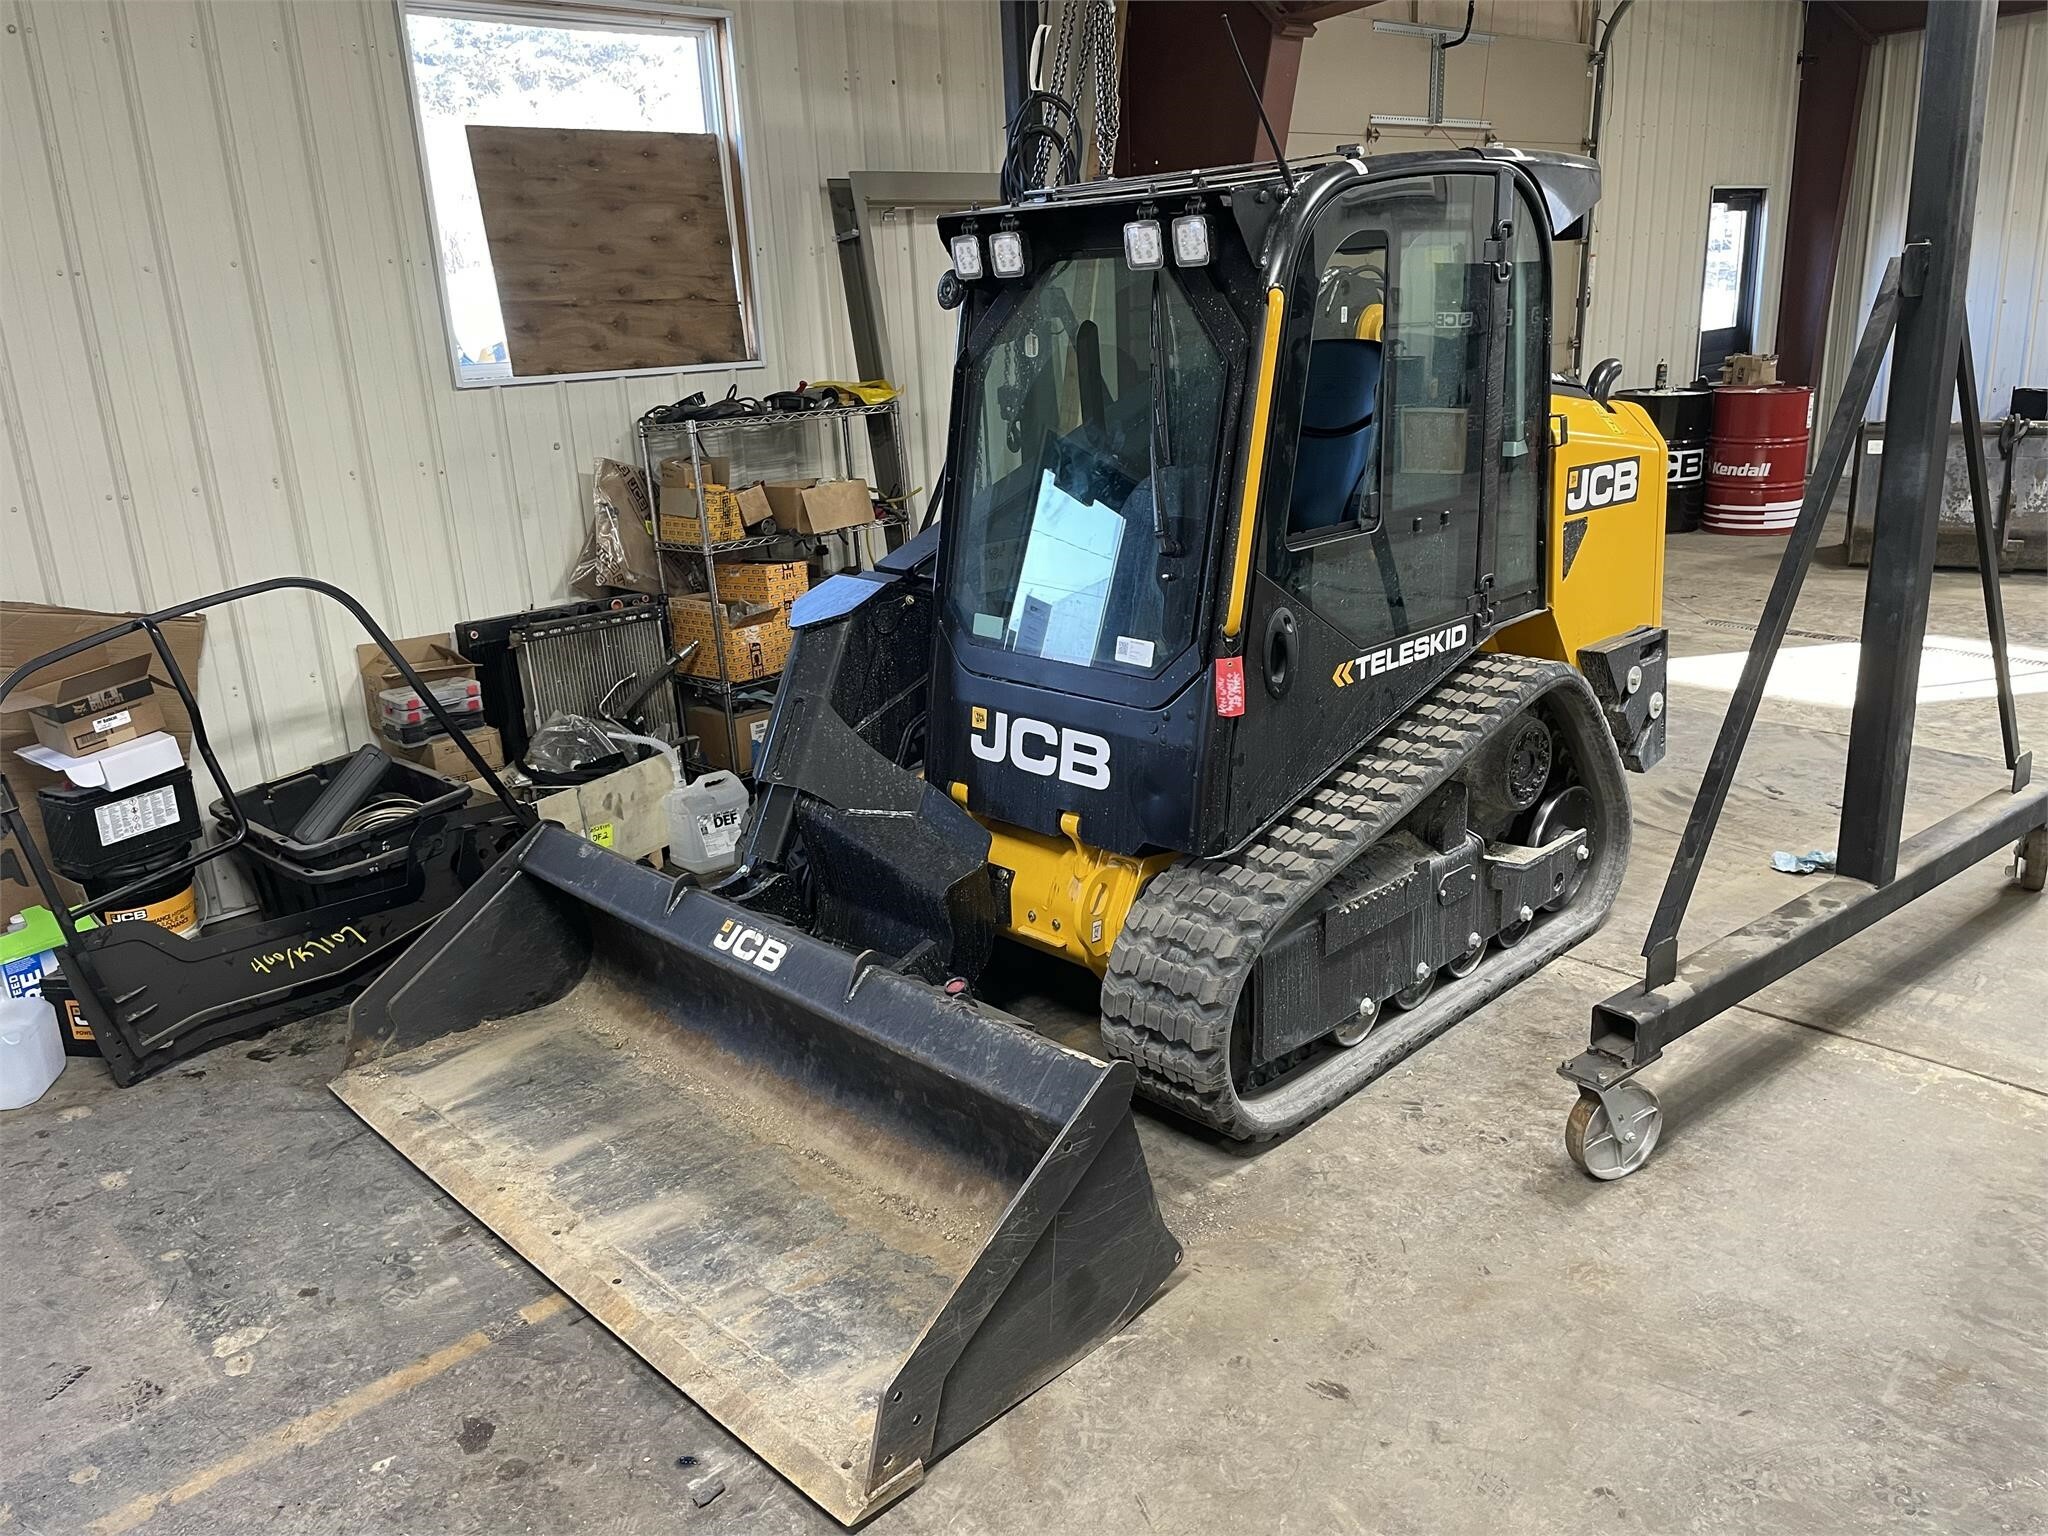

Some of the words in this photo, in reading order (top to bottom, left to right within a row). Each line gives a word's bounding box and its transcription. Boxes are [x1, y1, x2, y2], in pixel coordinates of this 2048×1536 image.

[1567, 460, 1639, 511] JCB
[1712, 462, 1771, 477] Kendall
[1355, 623, 1467, 680] TELESKID
[971, 708, 1111, 790] JCB
[713, 812, 738, 829] DEF
[112, 911, 147, 923] JCB
[713, 920, 788, 972] JCB
